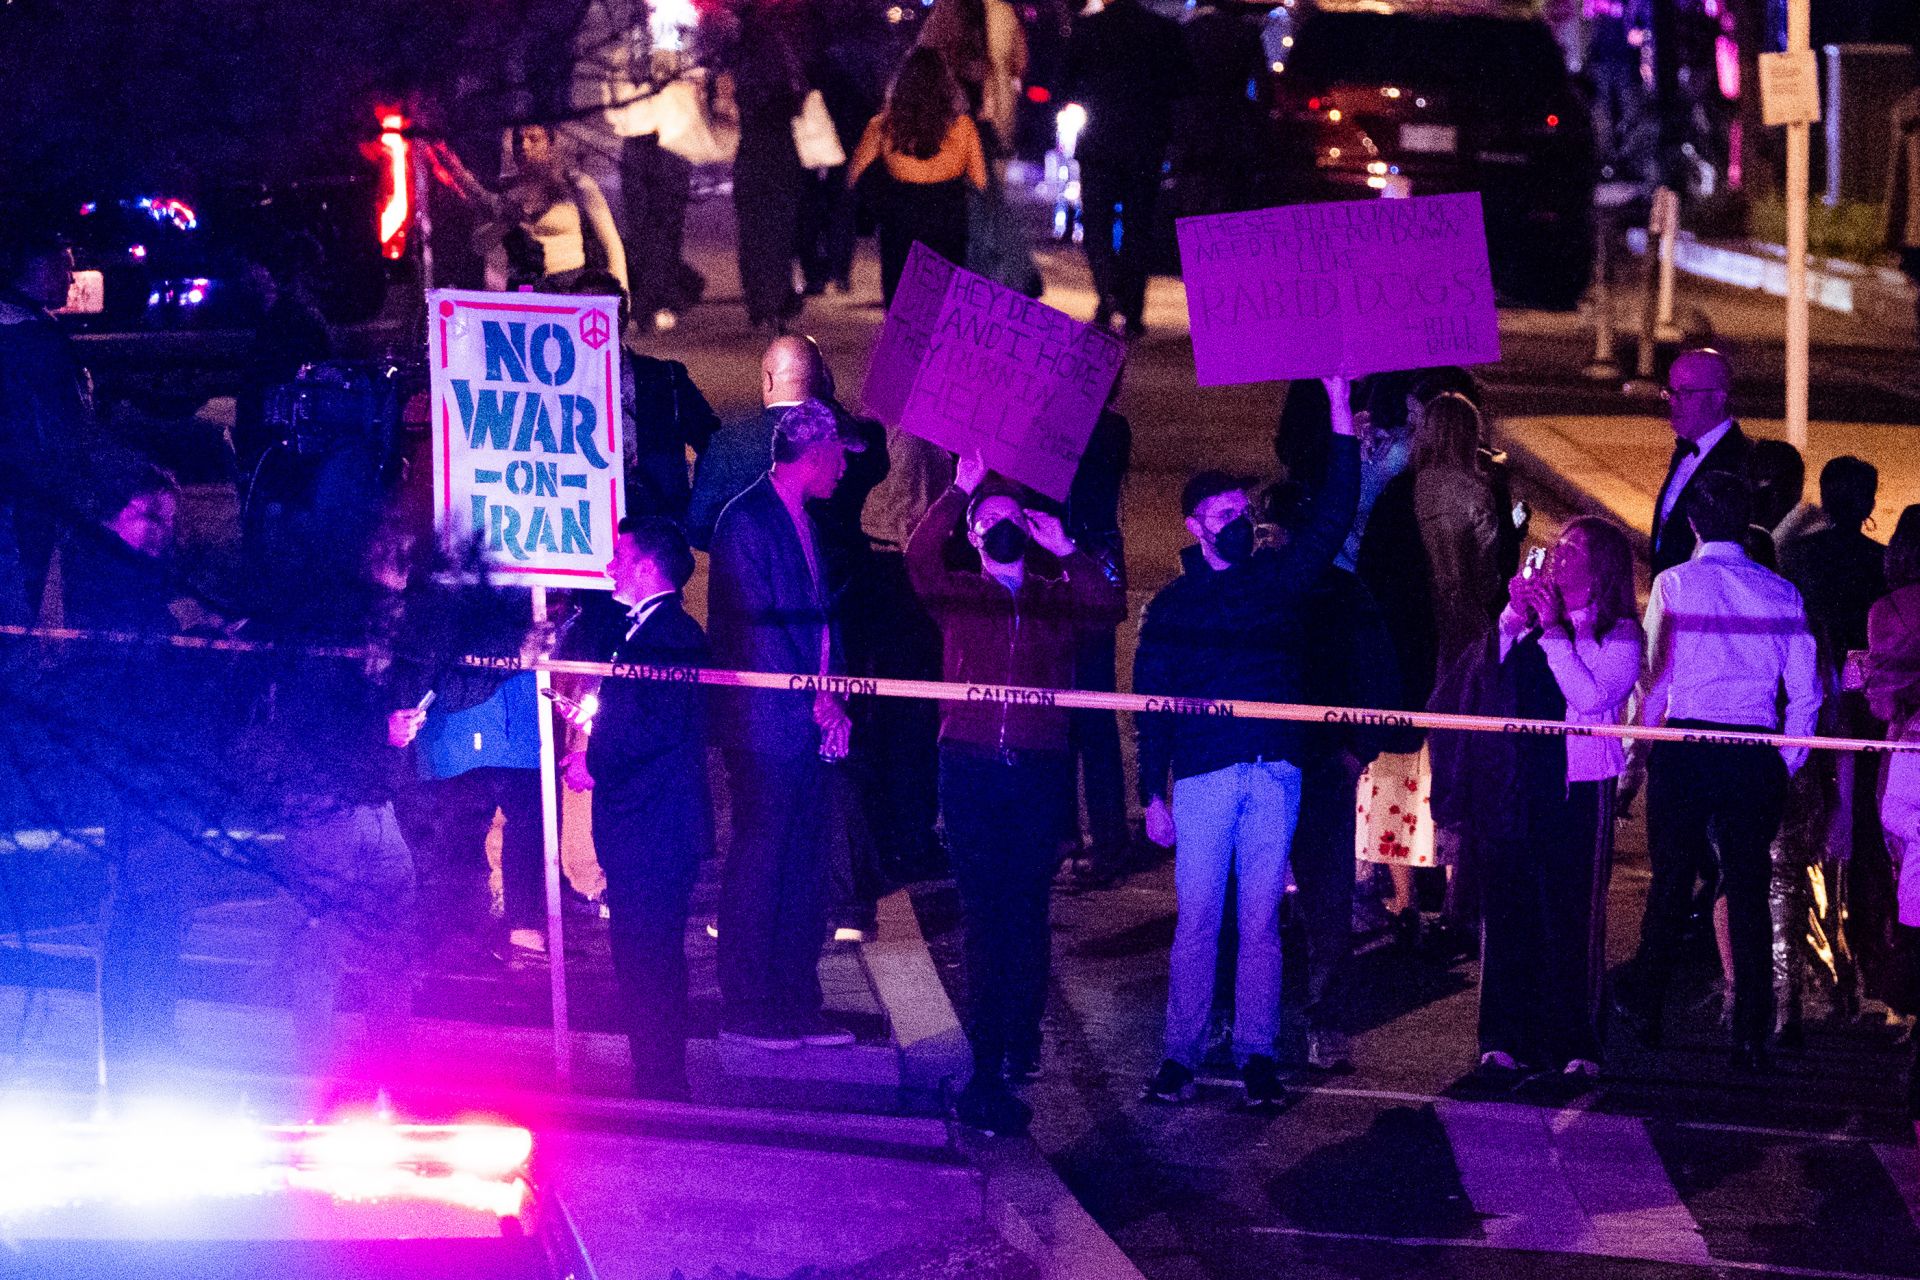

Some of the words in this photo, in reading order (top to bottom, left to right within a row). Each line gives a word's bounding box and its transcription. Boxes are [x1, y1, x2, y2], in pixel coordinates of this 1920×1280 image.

[1182, 212, 1280, 242] THESE
[1196, 238, 1262, 264] NEED
[1268, 234, 1304, 258] TO
[1345, 226, 1382, 244] PUT
[1391, 219, 1460, 246] DOWN
[1297, 249, 1362, 276] LIKE
[1200, 276, 1340, 330] RABID
[482, 320, 576, 386] NO
[890, 314, 943, 368] THEY
[944, 346, 1016, 392] BURN
[941, 306, 1003, 351] AND
[1004, 327, 1030, 362] I
[1035, 342, 1101, 398] HOPE
[450, 379, 609, 469] WAR
[470, 495, 594, 561] IRAN
[612, 663, 699, 682] CAUTION
[789, 675, 877, 695] CAUTION
[967, 687, 1055, 706] CAUTION
[1145, 698, 1233, 717] CAUTION
[1323, 710, 1412, 727] CAUTION
